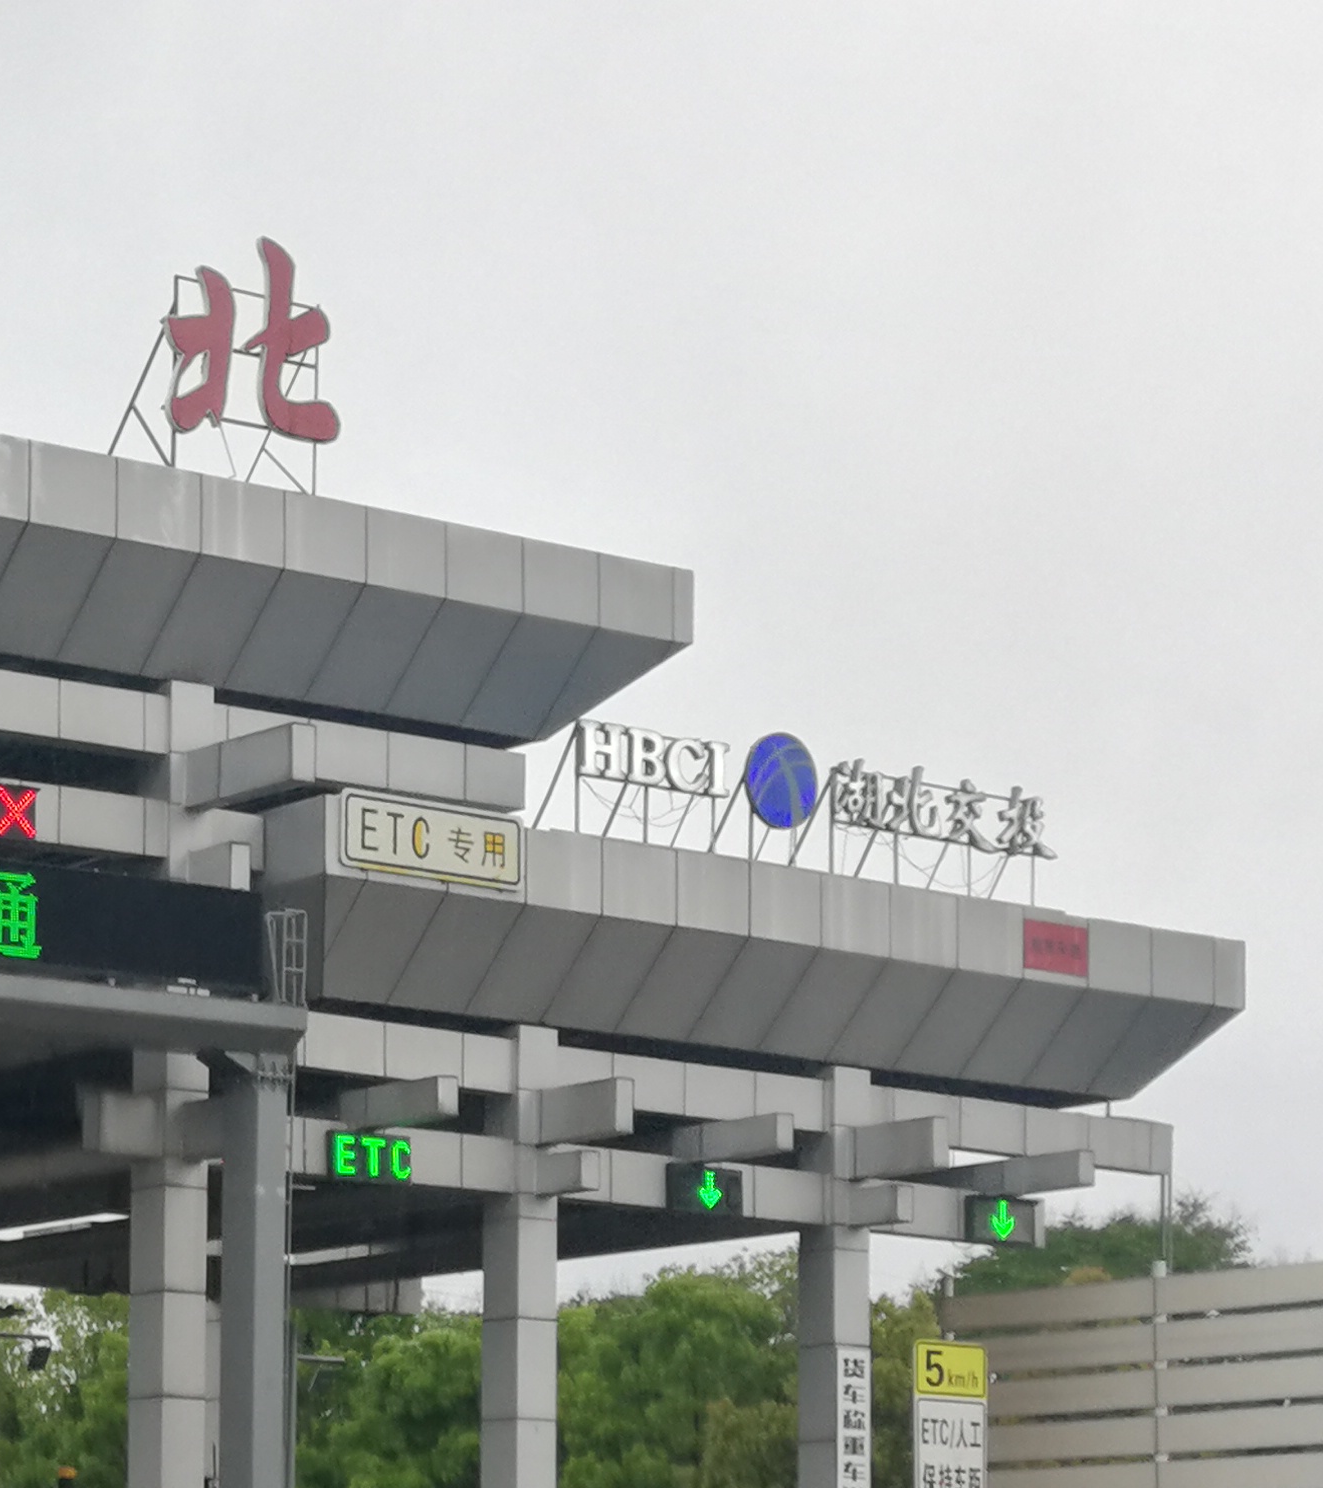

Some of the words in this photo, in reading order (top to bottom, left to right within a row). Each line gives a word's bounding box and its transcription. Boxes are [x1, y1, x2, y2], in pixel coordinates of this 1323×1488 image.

[576, 718, 730, 798] HBCI
[830, 757, 1058, 860] 湖北交投
[361, 807, 430, 859] ETC
[448, 827, 505, 869] 专用
[335, 1134, 412, 1180] ETC
[925, 1349, 944, 1387] 5
[947, 1368, 979, 1389] km/h
[921, 1418, 982, 1448] ETC/人工
